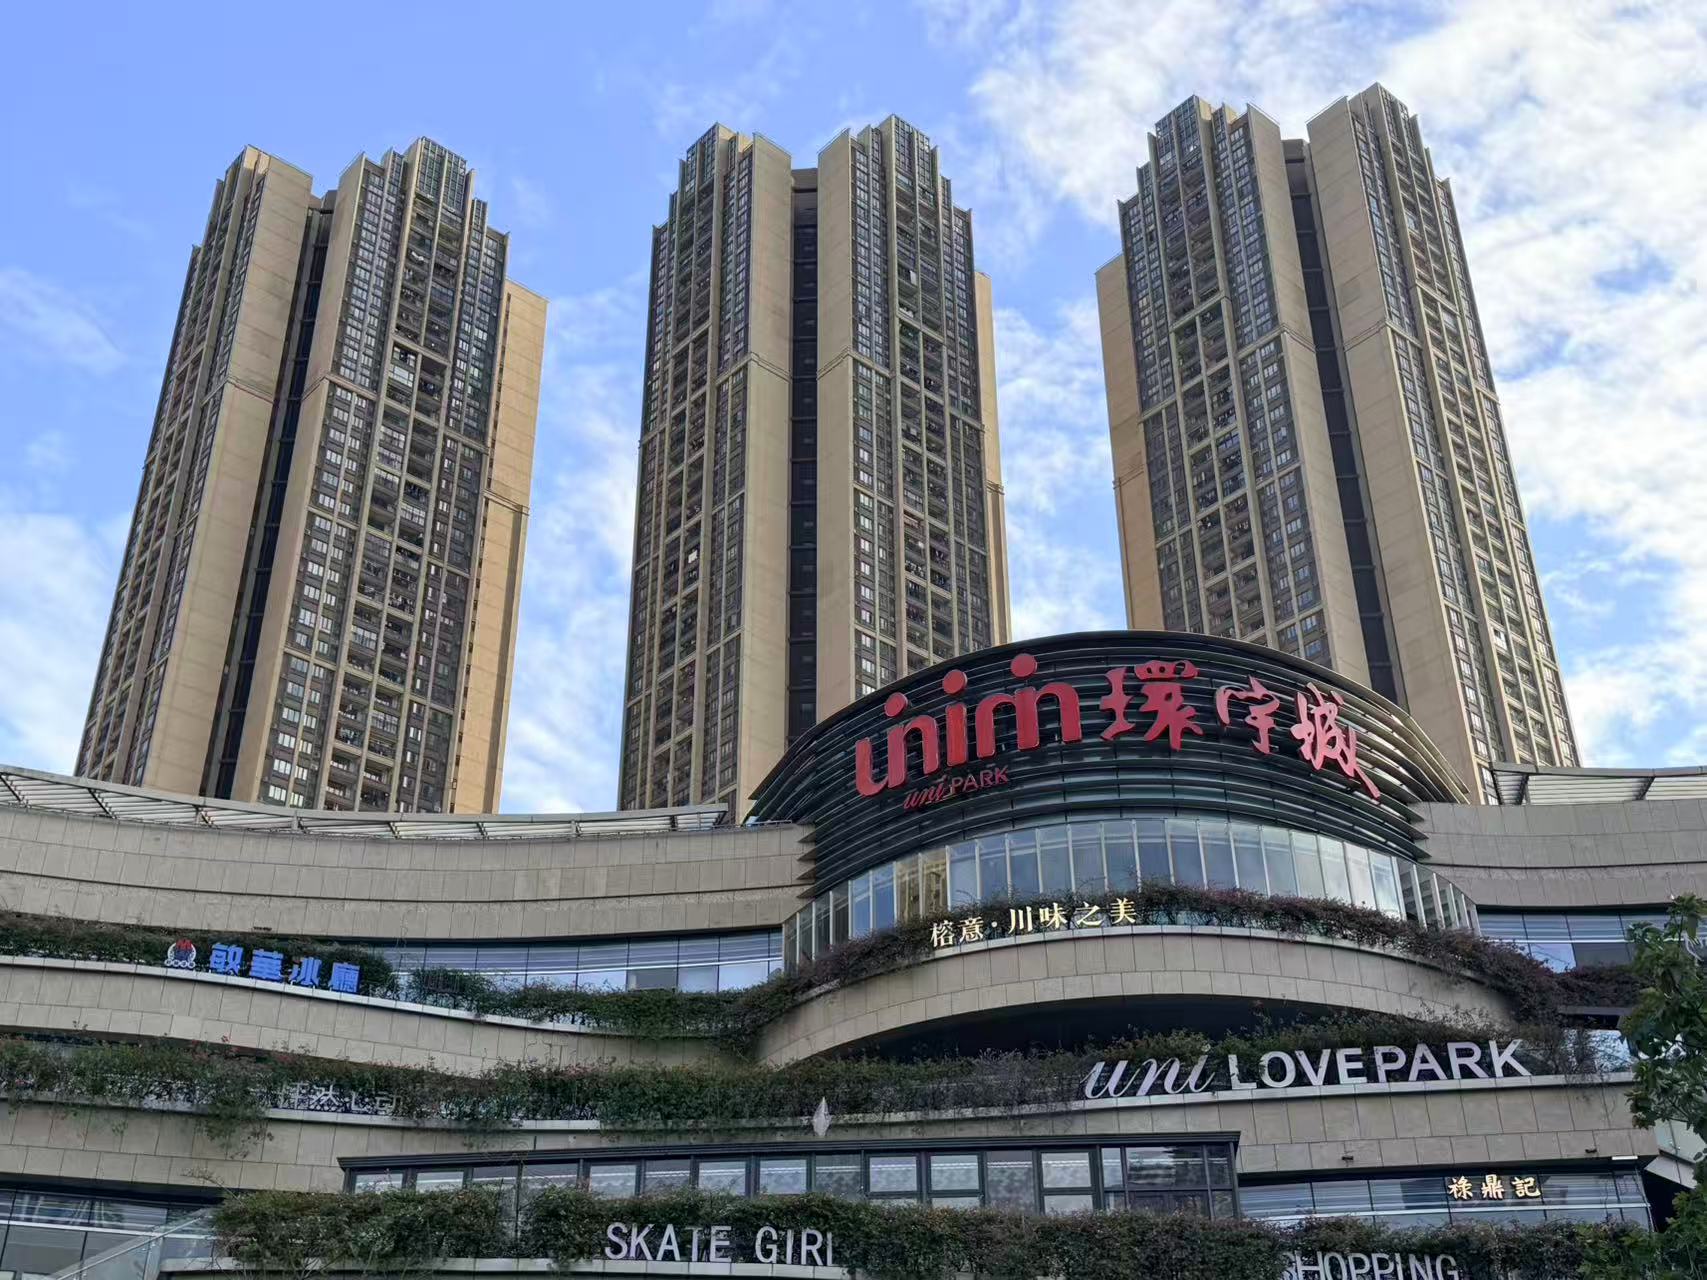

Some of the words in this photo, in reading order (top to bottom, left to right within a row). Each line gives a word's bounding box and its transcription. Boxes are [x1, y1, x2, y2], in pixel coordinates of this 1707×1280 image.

[948, 765, 1009, 796] PARK
[1080, 1043, 1216, 1099] uni
[604, 1221, 732, 1263] SKATE
